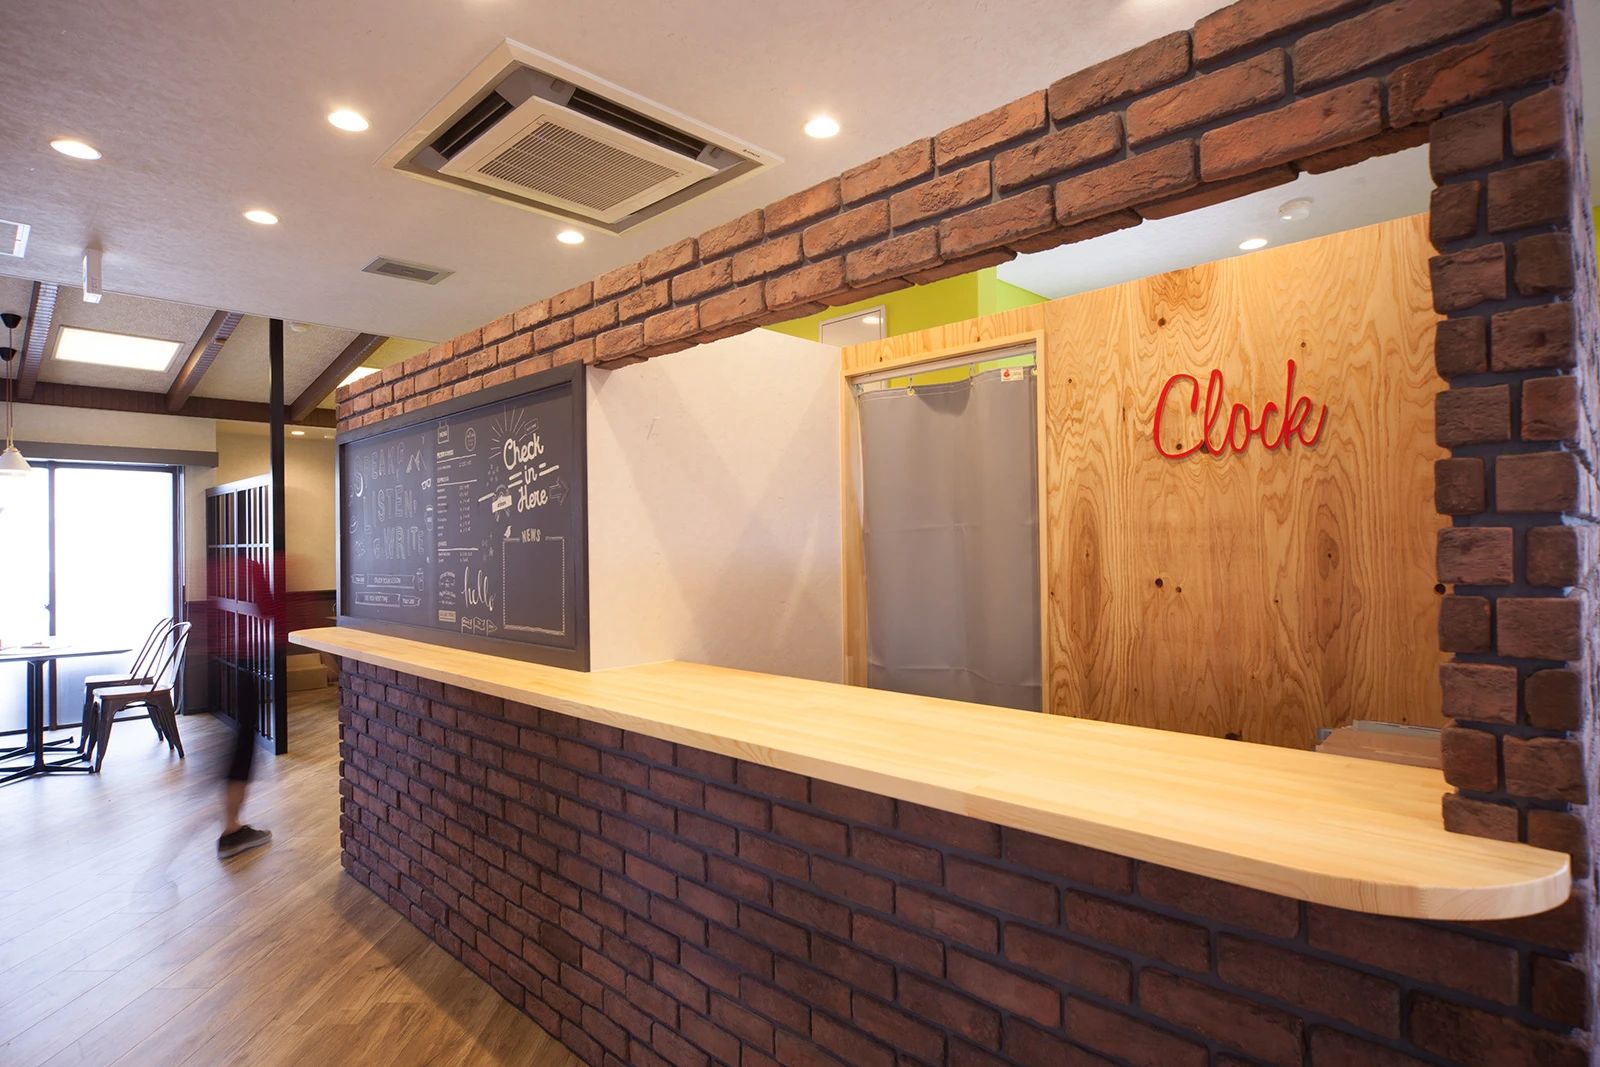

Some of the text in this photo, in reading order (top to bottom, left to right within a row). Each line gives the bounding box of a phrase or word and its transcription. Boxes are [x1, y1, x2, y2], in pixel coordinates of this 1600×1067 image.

[1153, 359, 1328, 459] Clock
[503, 433, 544, 470] Check
[524, 465, 537, 485] in
[517, 485, 548, 513] Here
[521, 528, 541, 543] NEWS
[461, 566, 497, 611] hello
